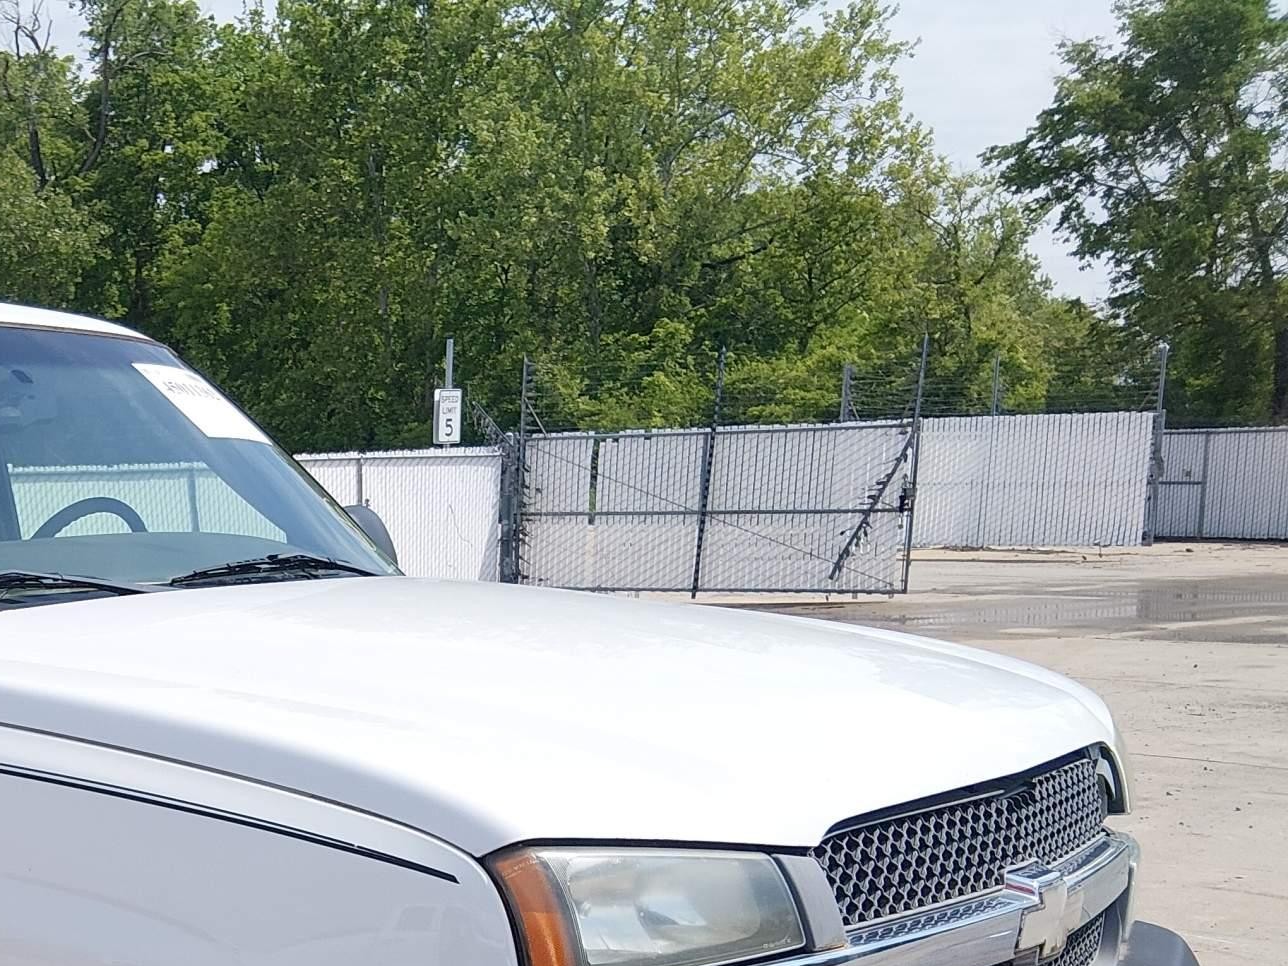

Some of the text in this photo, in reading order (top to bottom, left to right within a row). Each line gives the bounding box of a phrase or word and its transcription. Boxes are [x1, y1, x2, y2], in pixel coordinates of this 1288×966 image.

[441, 395, 459, 404] SPEED
[442, 406, 458, 415] LIMIT
[444, 418, 454, 437] 5
